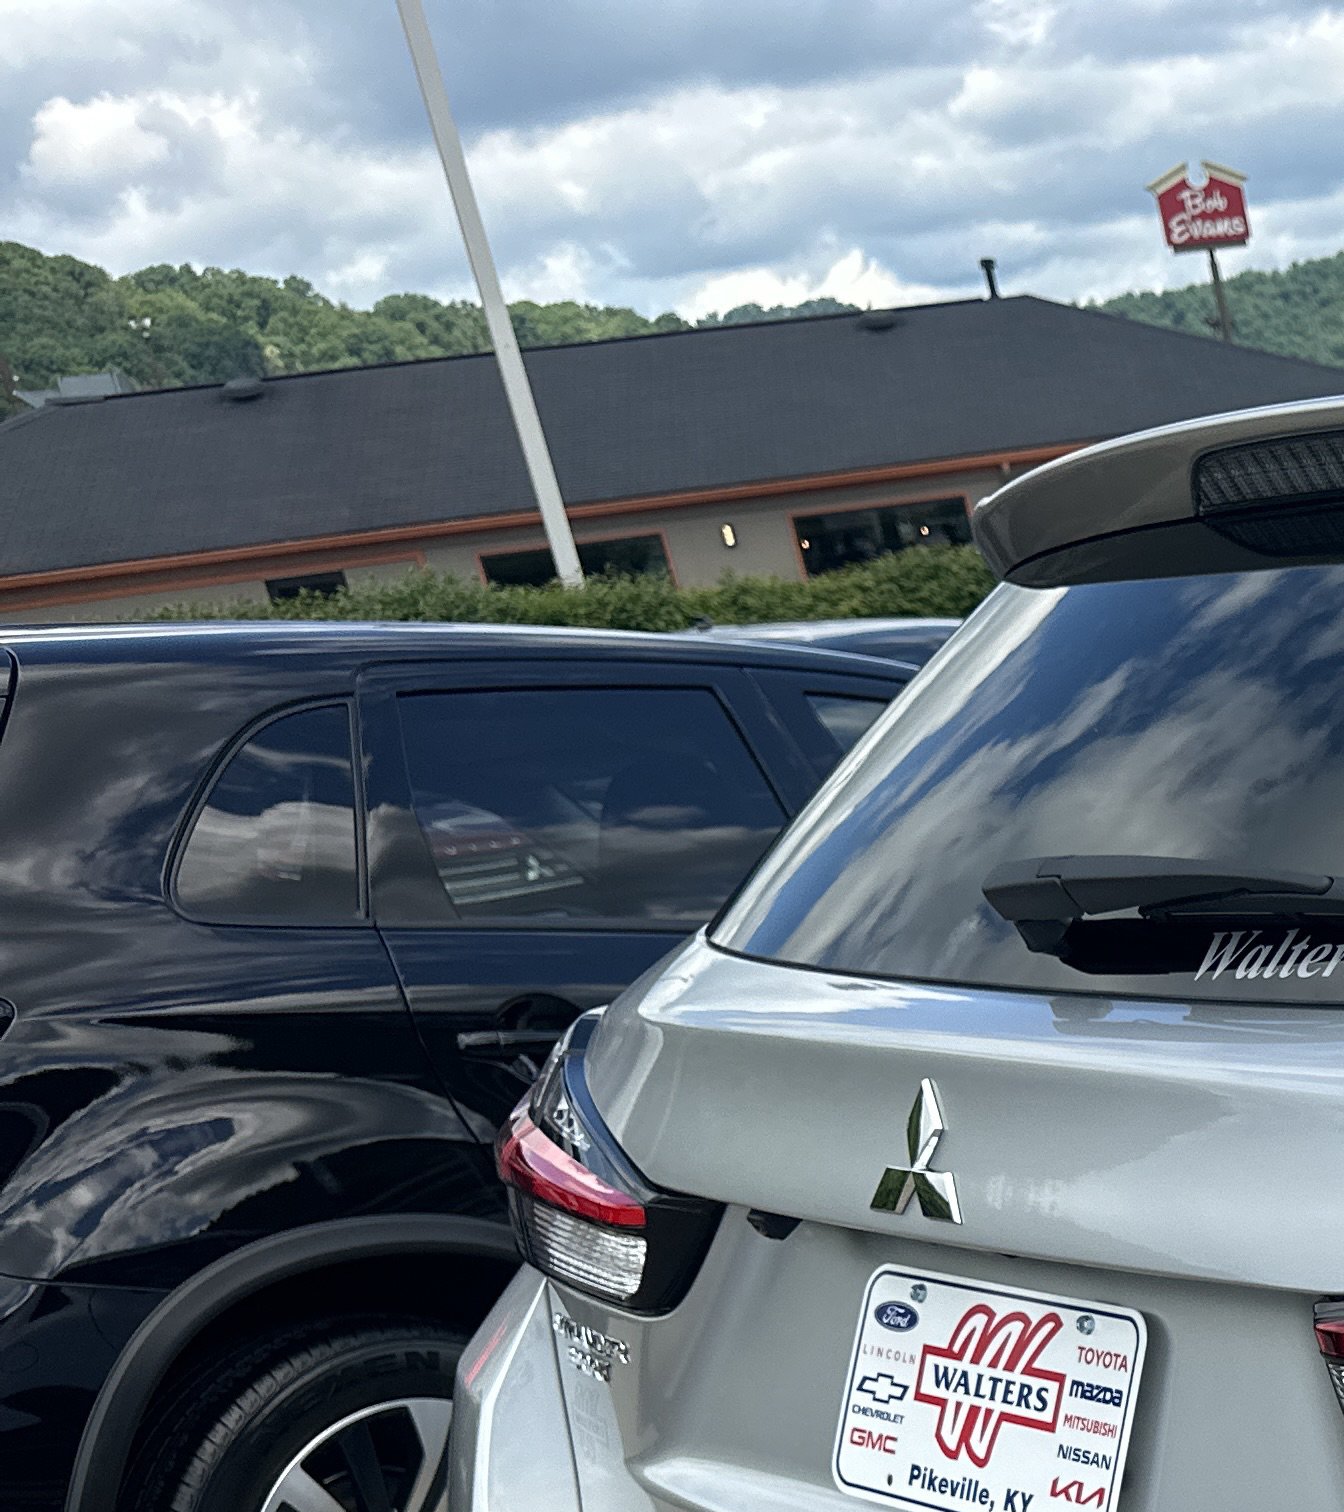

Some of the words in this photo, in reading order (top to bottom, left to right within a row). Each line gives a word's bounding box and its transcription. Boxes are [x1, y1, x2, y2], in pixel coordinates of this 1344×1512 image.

[1176, 190, 1228, 216] Bob
[1169, 213, 1246, 243] Evans
[881, 1304, 913, 1329] Ford
[863, 1344, 916, 1364] LINCOLN
[1077, 1346, 1128, 1373] TOYOTA
[934, 1364, 1049, 1412] WALTERS
[851, 1404, 905, 1425] CHEVROLET
[1063, 1413, 1118, 1439] MITSUBISHI
[849, 1427, 898, 1454] GMC
[1056, 1444, 1112, 1470] NISSAN
[908, 1464, 995, 1512] Pikeville,
